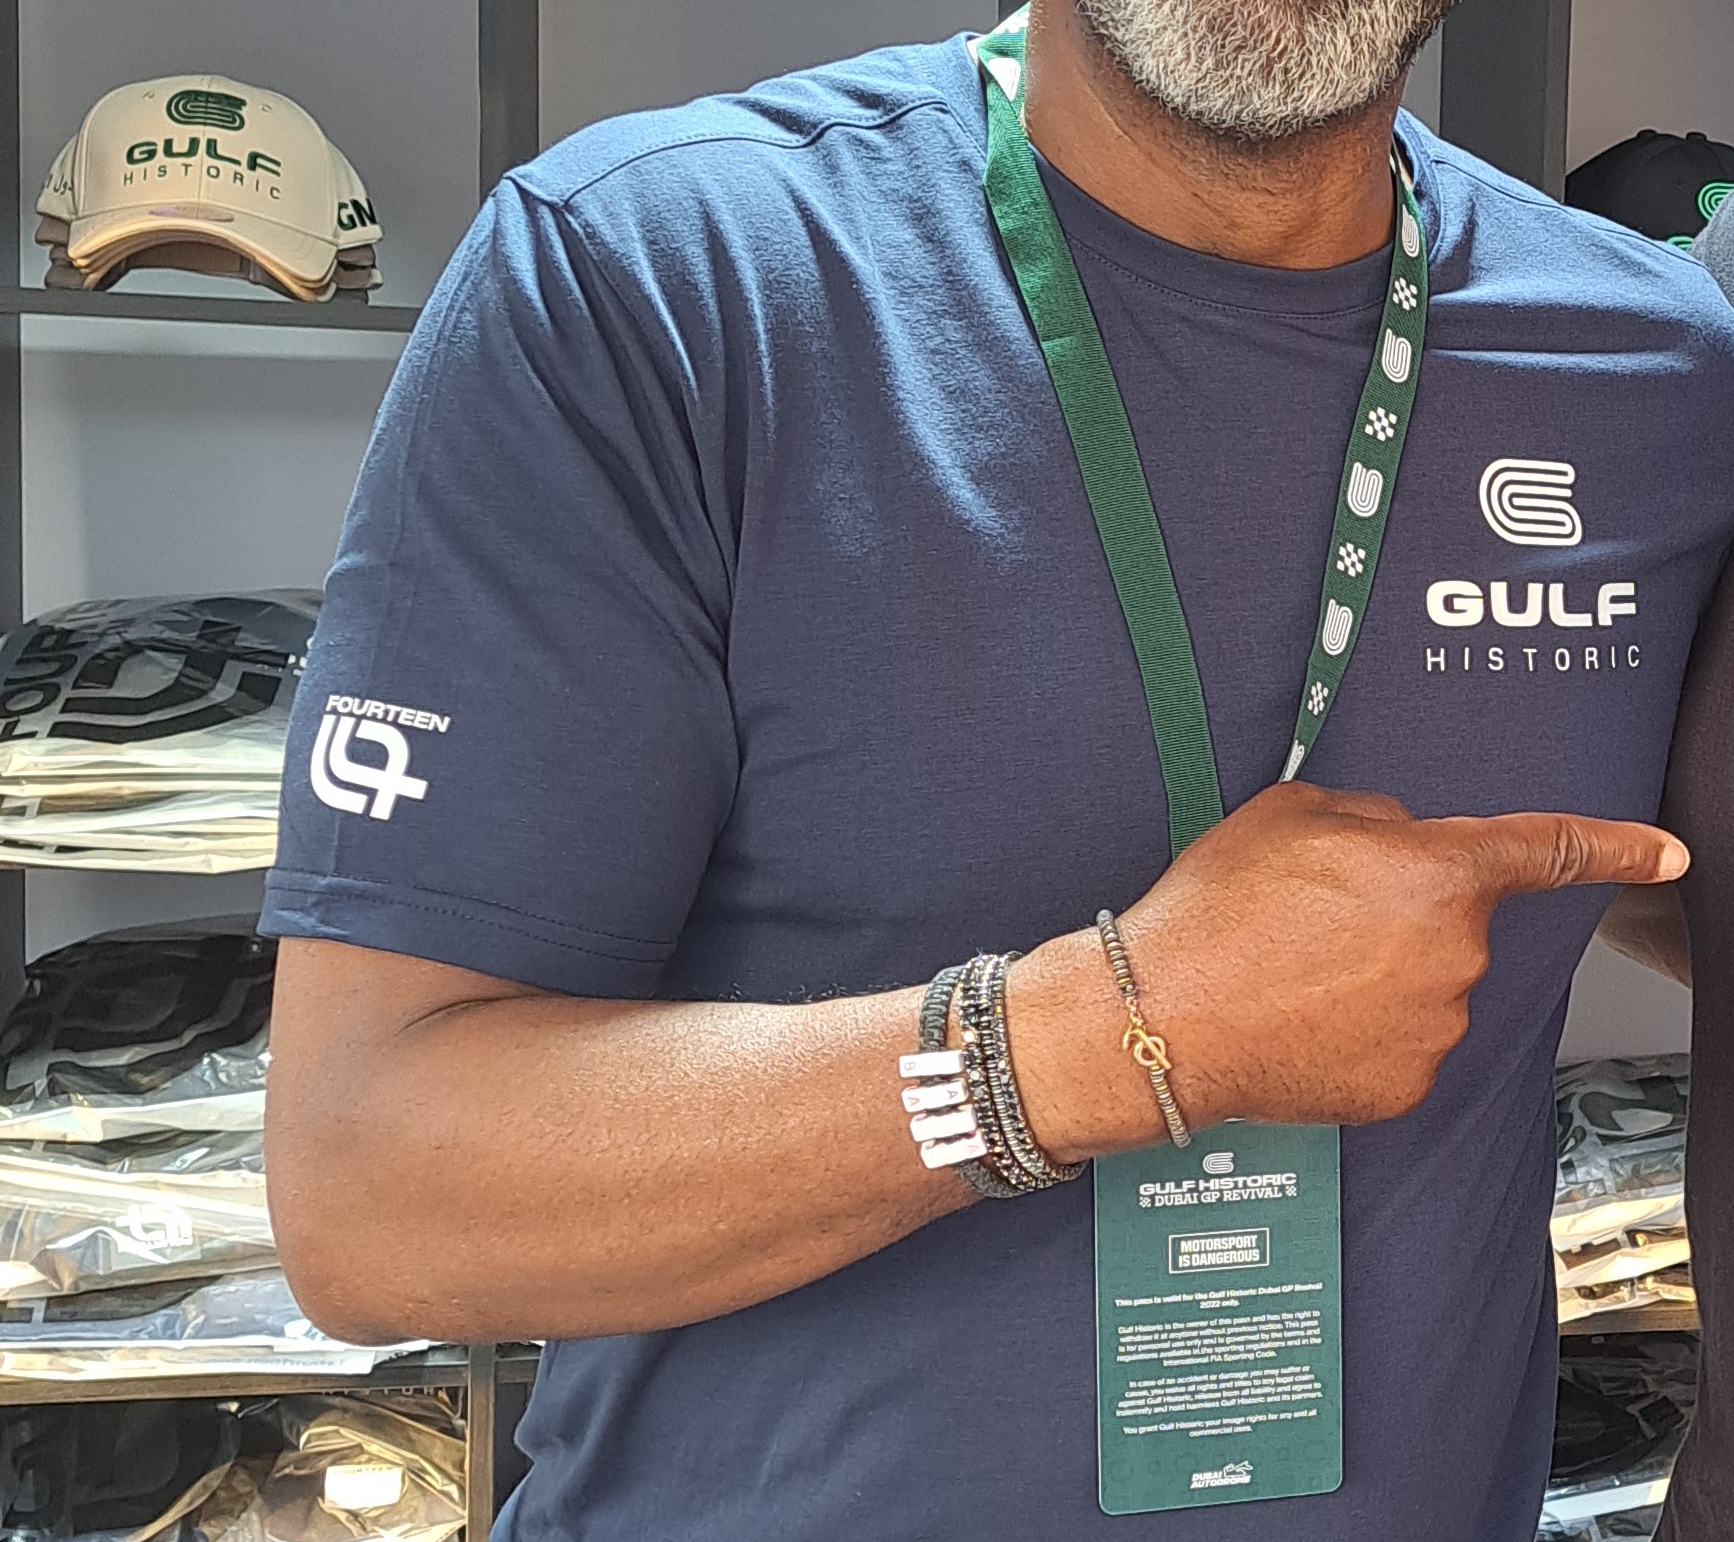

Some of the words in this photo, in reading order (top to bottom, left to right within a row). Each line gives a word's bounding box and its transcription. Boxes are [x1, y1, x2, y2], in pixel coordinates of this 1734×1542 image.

[125, 136, 282, 179] GULF
[122, 163, 282, 201] HISTORIC
[1425, 580, 1638, 628] GULF
[1425, 644, 1642, 673] HISTORIC
[324, 694, 451, 734] FOURTEEN
[1139, 1180, 1196, 1196] GULF
[1198, 1173, 1297, 1190] HISTORIC
[1154, 1192, 1199, 1207] DUBAI
[1200, 1190, 1221, 1203] GP
[1222, 1186, 1283, 1202] REVIVAL
[1180, 1235, 1258, 1253] MOTORSPORT
[1178, 1255, 1191, 1268] IS
[1191, 1248, 1260, 1267] DANGEROUS
[1192, 1471, 1222, 1481] DUBAI
